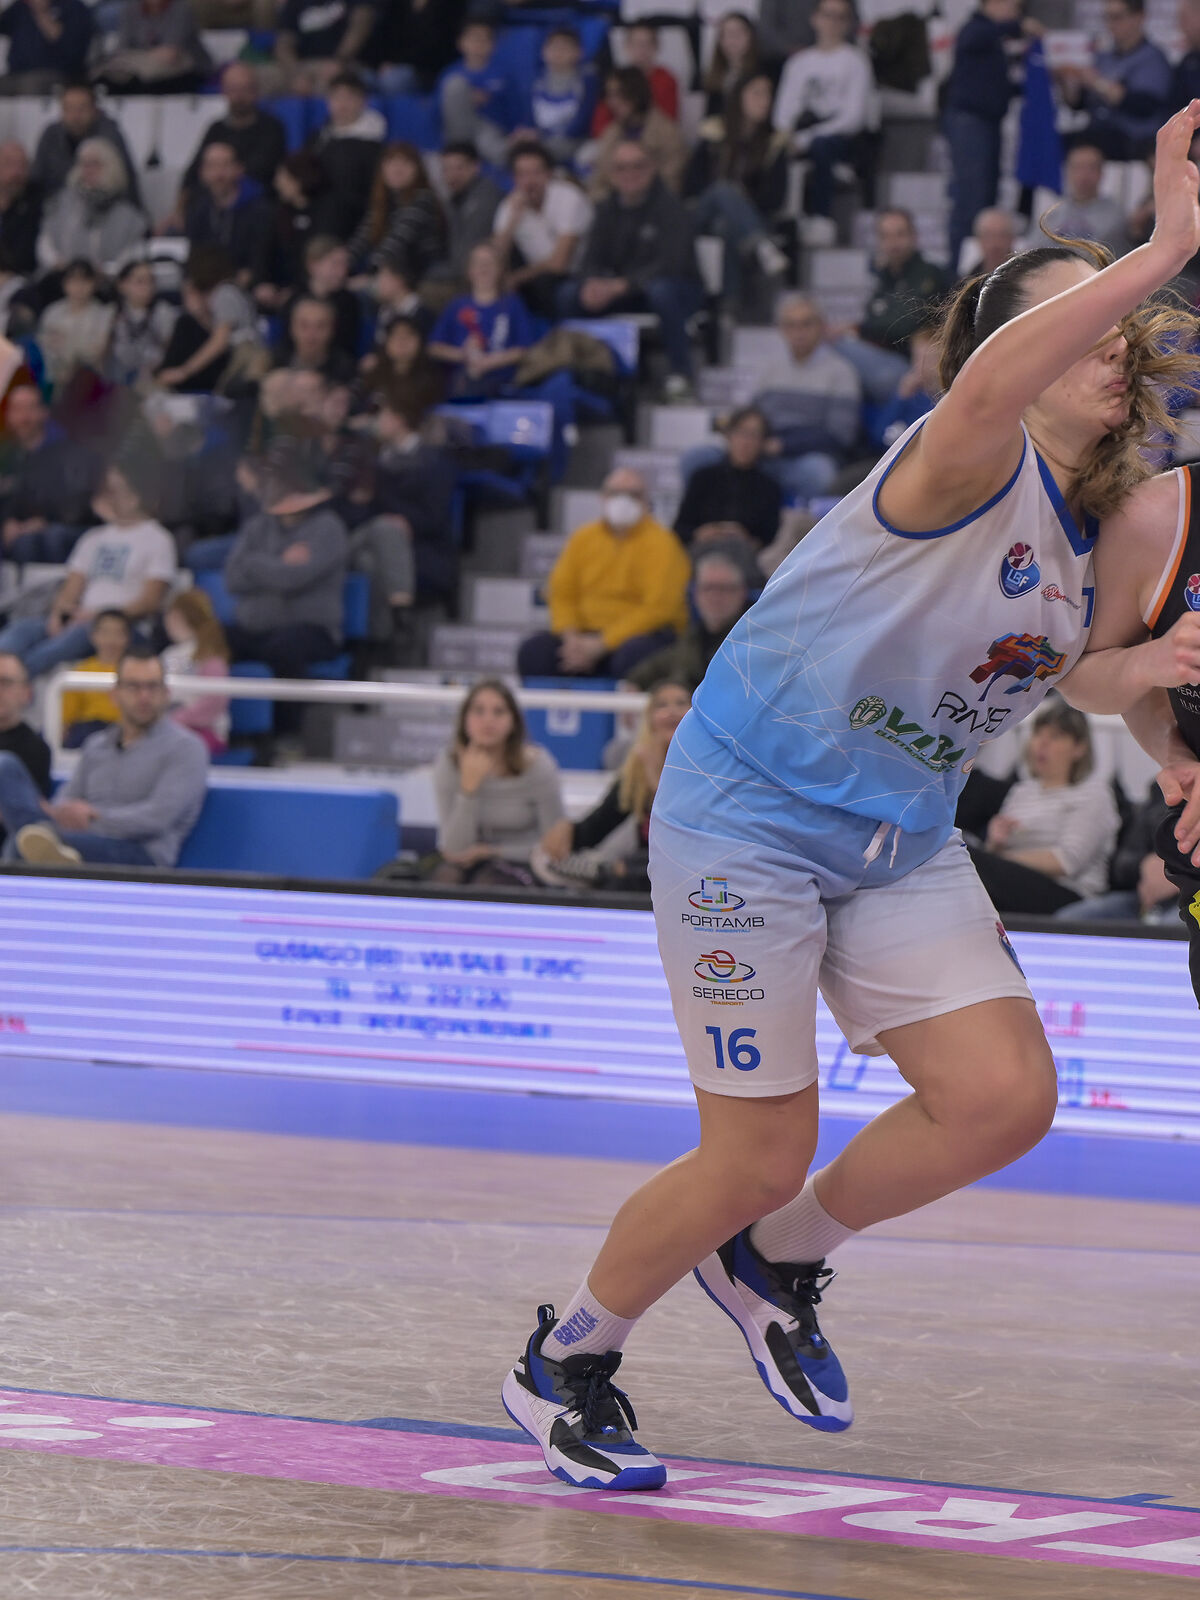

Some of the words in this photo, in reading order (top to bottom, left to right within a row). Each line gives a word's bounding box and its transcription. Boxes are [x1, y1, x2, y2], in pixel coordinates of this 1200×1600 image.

[681, 913, 764, 928] PORTAMB
[692, 986, 764, 1001] SERECO
[705, 1025, 762, 1072] 16
[553, 1306, 600, 1346] BRIXIA
